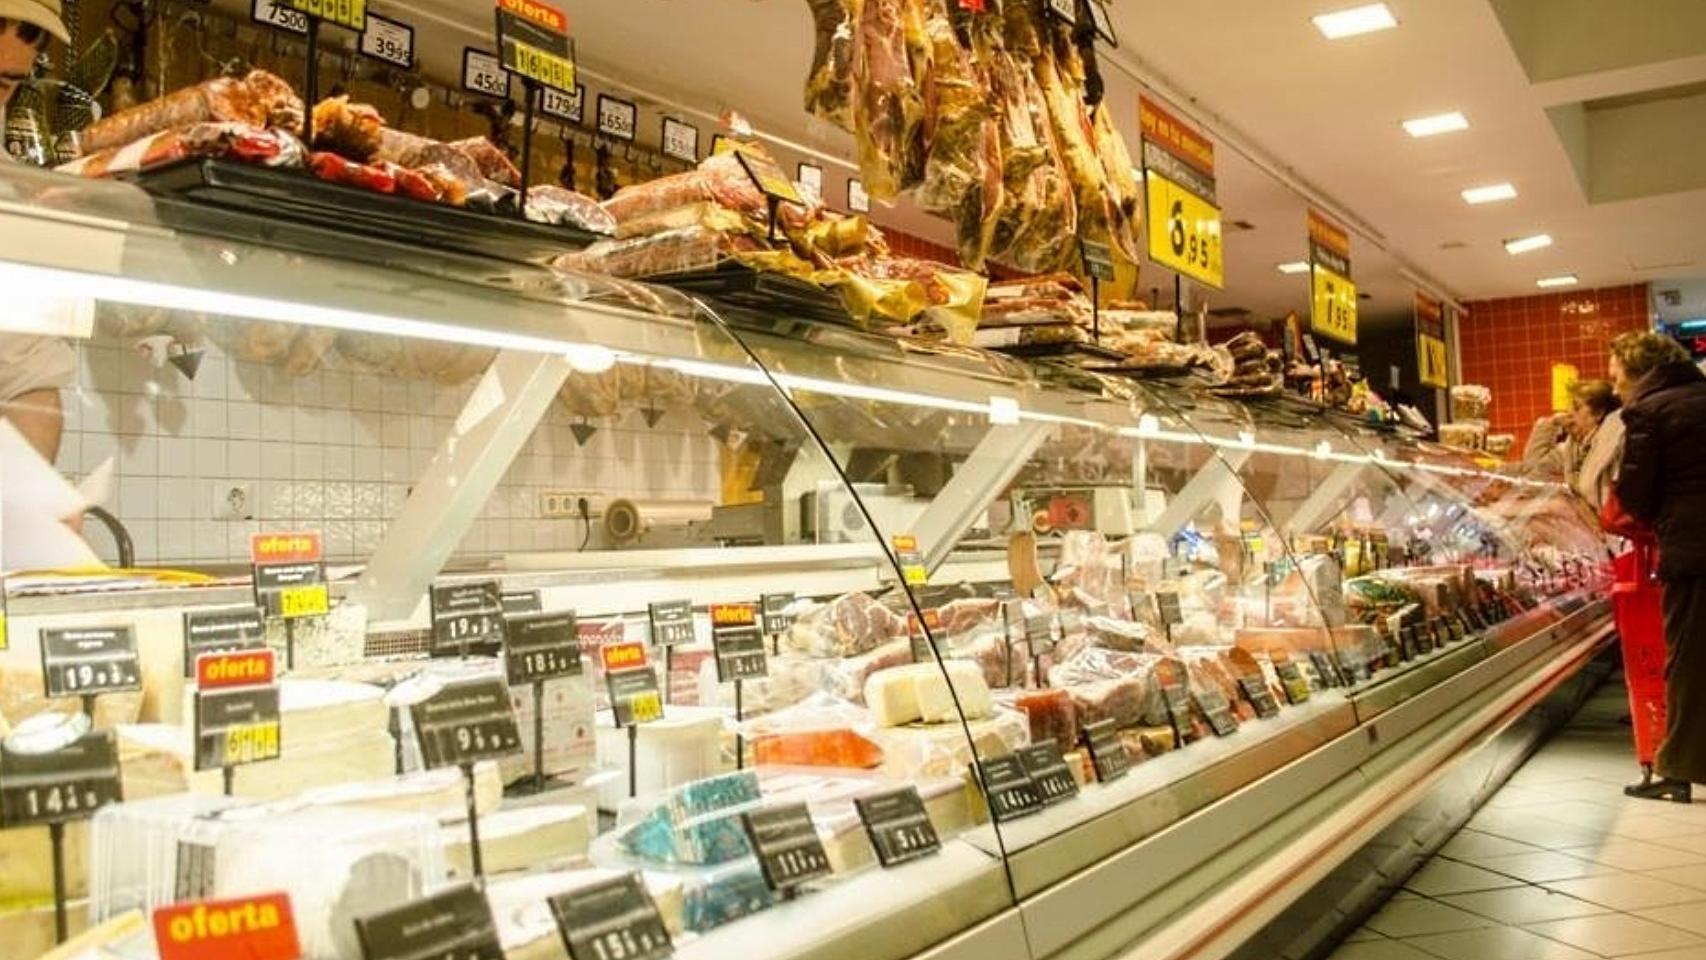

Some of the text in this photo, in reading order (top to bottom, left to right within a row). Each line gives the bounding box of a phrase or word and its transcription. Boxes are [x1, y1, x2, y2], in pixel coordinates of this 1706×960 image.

[258, 536, 313, 554] oferta
[206, 656, 266, 680] oferta
[169, 901, 280, 943] oferta
